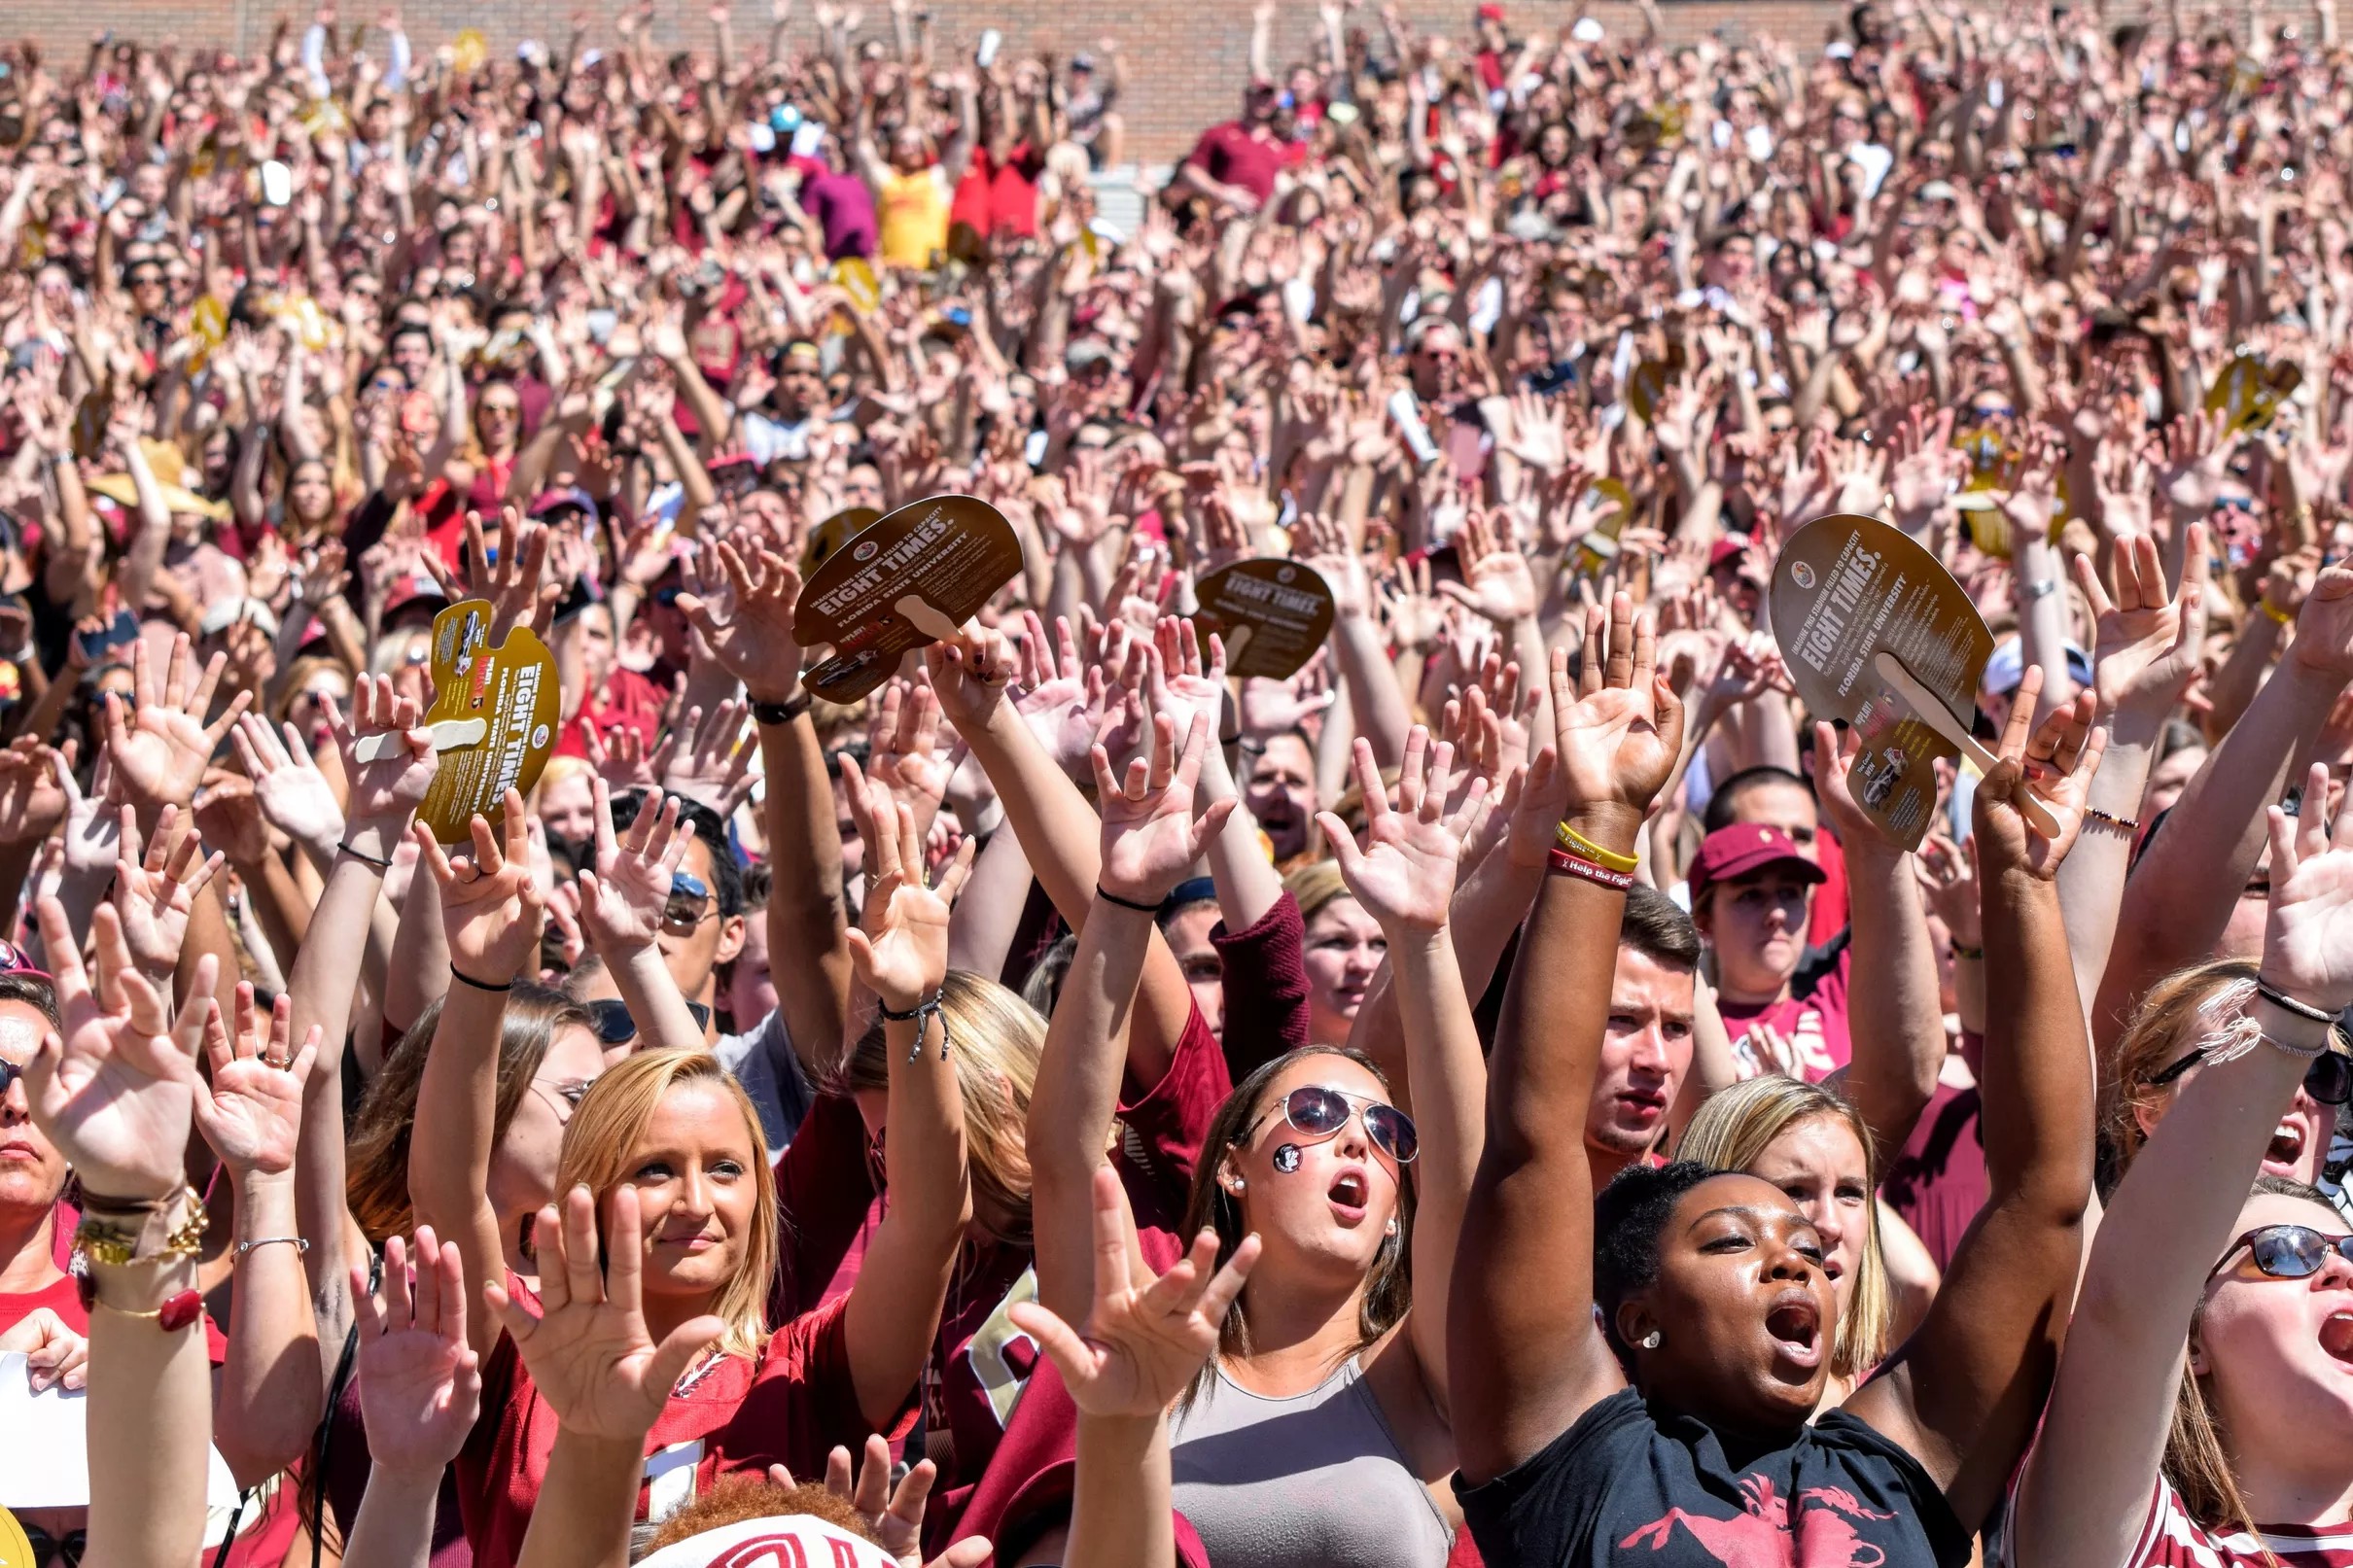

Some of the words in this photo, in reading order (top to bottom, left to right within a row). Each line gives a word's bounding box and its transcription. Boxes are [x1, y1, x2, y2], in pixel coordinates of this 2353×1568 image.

[809, 587, 839, 609] IMAGINE
[838, 576, 855, 589] THIS
[854, 556, 884, 578] STADIUM
[882, 540, 904, 558] FILLED
[902, 532, 913, 540] TO
[913, 505, 942, 533] CAPACITY
[817, 568, 882, 615] EIGHT
[881, 517, 954, 571] TIMES.
[836, 598, 881, 628] FLORIDA
[882, 577, 911, 598] STATE
[912, 531, 966, 577] UNIVERSITY
[1790, 627, 1809, 655] IMAGINE
[1803, 613, 1815, 629] THIS
[1810, 587, 1829, 616] STADIUM
[1824, 569, 1840, 590] FILLED
[1835, 559, 1844, 571] TO
[1840, 529, 1861, 561] CAPACITY
[1801, 605, 1844, 671] EIGHT
[1830, 545, 1880, 613] TIMES.
[530, 662, 542, 693] IMAGINE
[1837, 656, 1864, 697] FLORIDA
[1859, 629, 1878, 657] STATE
[495, 667, 509, 714] FLORIDA
[510, 665, 538, 732] EIGHT
[528, 694, 537, 711] THIS
[522, 712, 533, 744] STADIUM
[1855, 700, 1874, 723] PLAY!
[488, 717, 500, 748] STATE
[488, 738, 522, 810] TIMES.
[513, 768, 520, 778] TO
[516, 745, 526, 767] FILLED
[1861, 750, 1873, 765] Could
[1864, 761, 1876, 777] WIN
[472, 750, 493, 811] UNIVERSITY
[1569, 860, 1593, 876] Help
[1595, 869, 1610, 881] the
